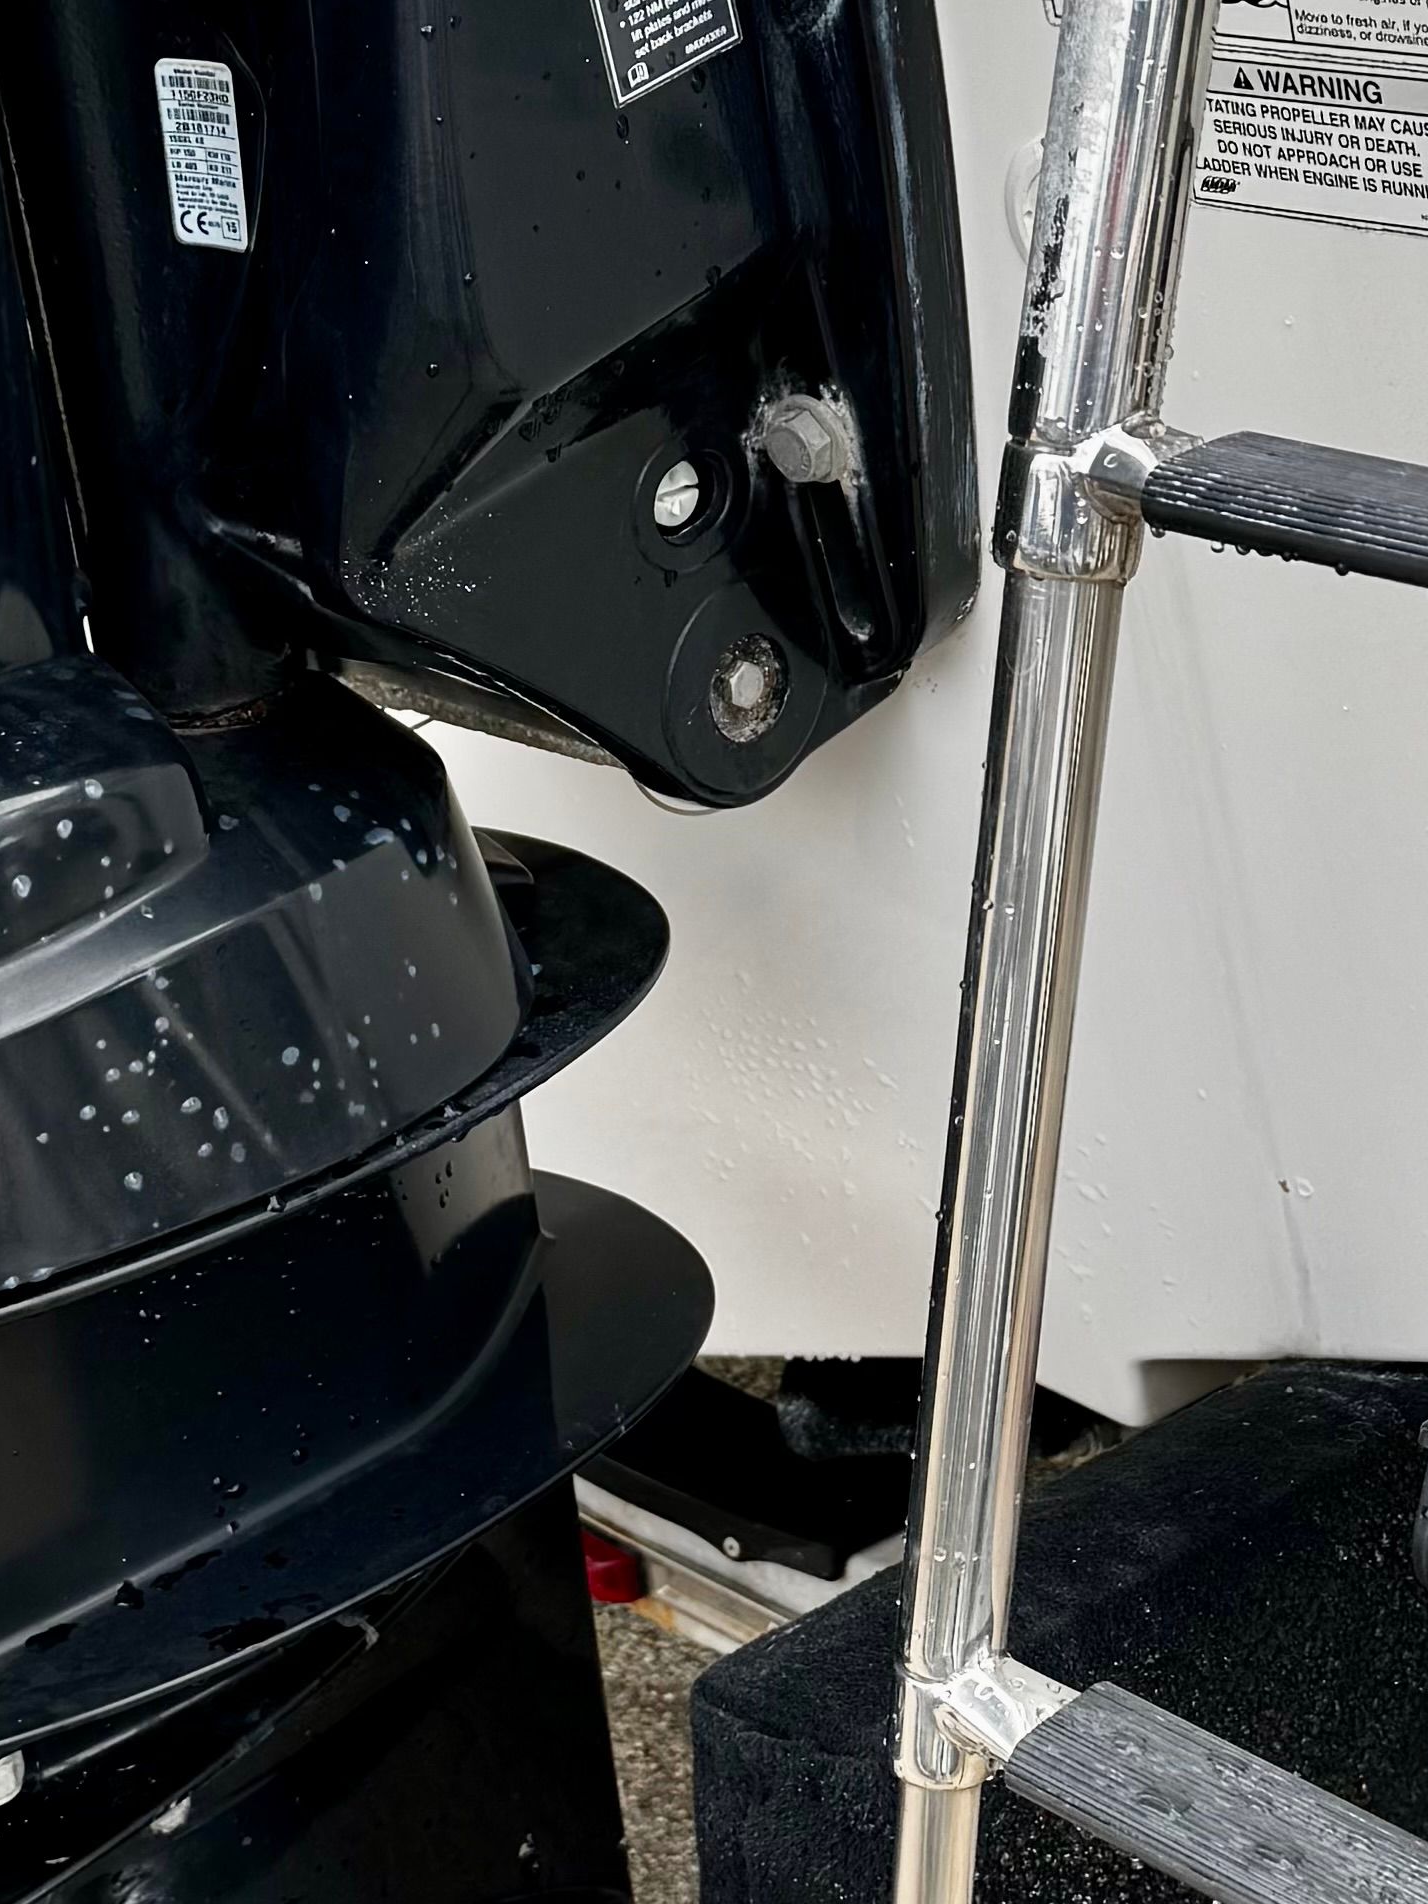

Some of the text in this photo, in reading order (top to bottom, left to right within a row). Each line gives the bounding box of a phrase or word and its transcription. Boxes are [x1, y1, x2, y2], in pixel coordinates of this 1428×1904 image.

[628, 9, 645, 26] 122
[673, 1, 691, 21] and
[1294, 9, 1328, 24] Move
[1331, 13, 1343, 25] to
[1346, 14, 1377, 28] fresh
[1381, 18, 1399, 32] air,
[1403, 19, 1410, 31] if
[1296, 23, 1356, 41] dizziness,
[1359, 31, 1372, 41] or
[635, 42, 650, 59] set
[1257, 69, 1383, 104] WARNING
[1202, 97, 1257, 117] TATING
[1260, 104, 1350, 129] PROPELLER
[1354, 114, 1385, 132] MAY
[1213, 119, 1420, 157] SERIOUS INJURY OR DEATH.
[1217, 139, 1423, 178] DO NOT APPROACH OR USE
[1195, 155, 1251, 176] LADDER
[1254, 163, 1299, 182] WHEN
[1302, 170, 1360, 190] ENGINE
[1362, 177, 1378, 193] IS
